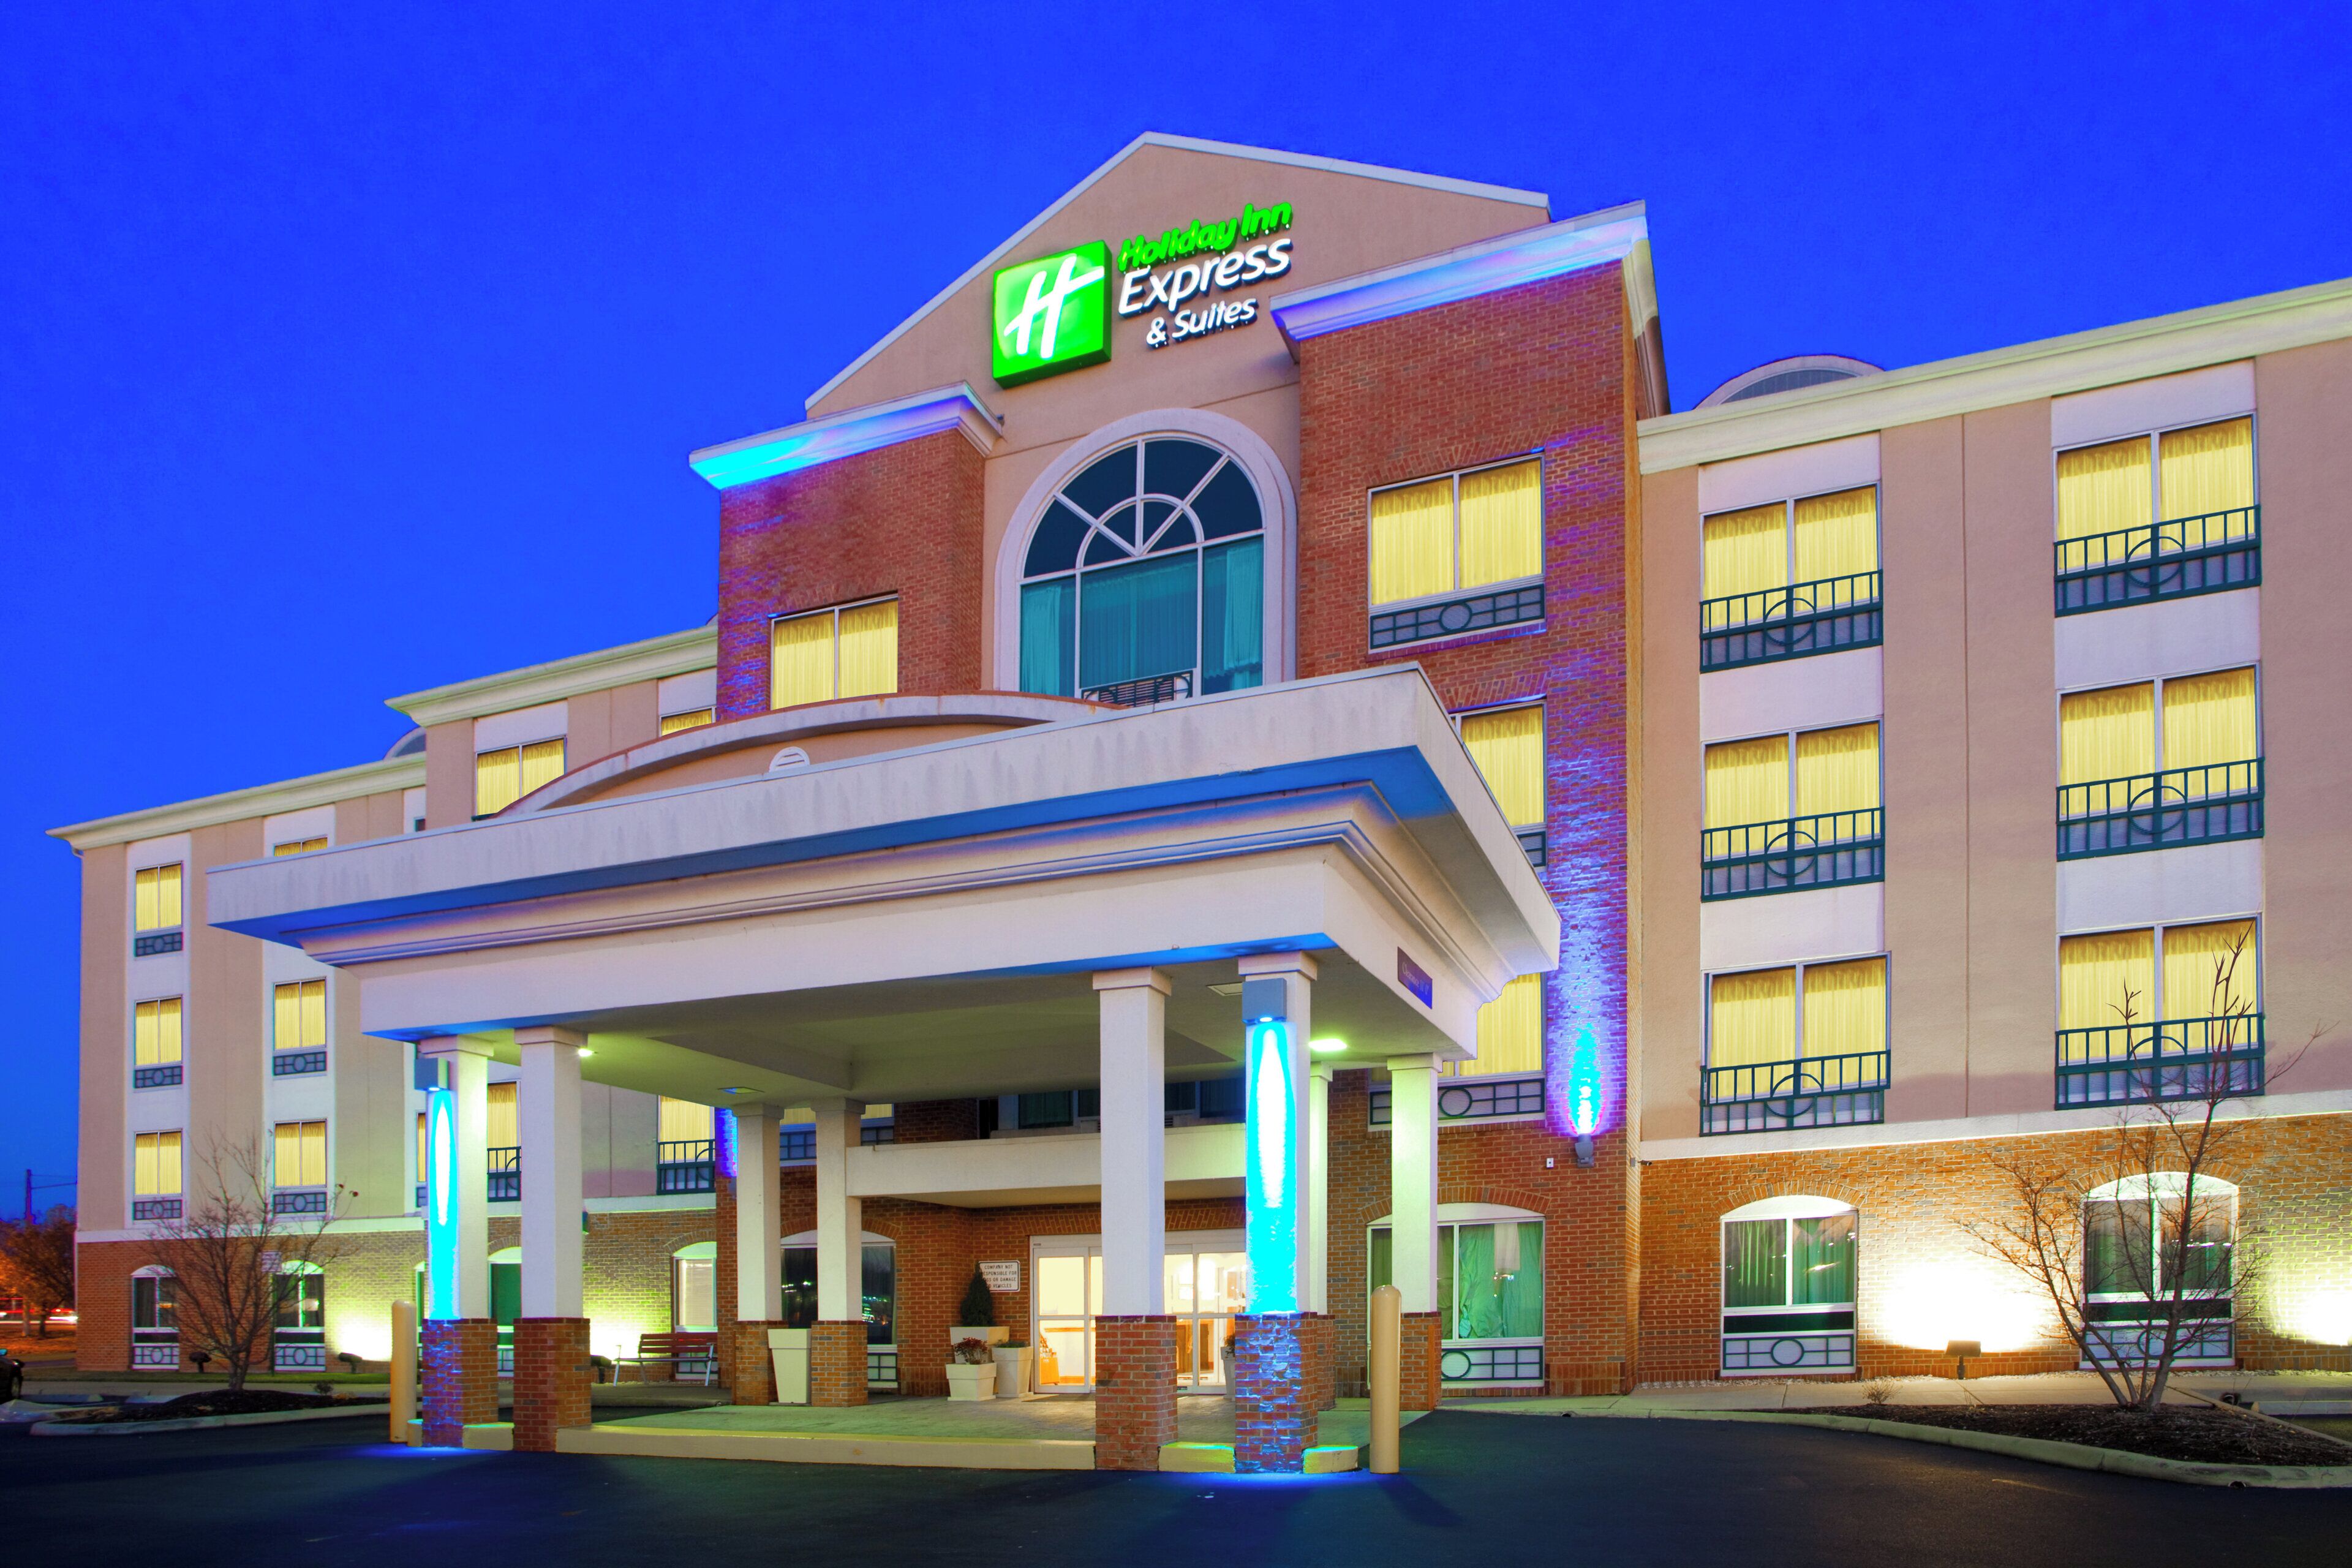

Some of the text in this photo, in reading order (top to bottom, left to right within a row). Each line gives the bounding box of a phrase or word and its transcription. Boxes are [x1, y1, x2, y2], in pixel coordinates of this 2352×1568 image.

[1117, 202, 1293, 271] Holiday Inn
[1118, 238, 1292, 317] Express
[1146, 298, 1258, 347] & Suites
